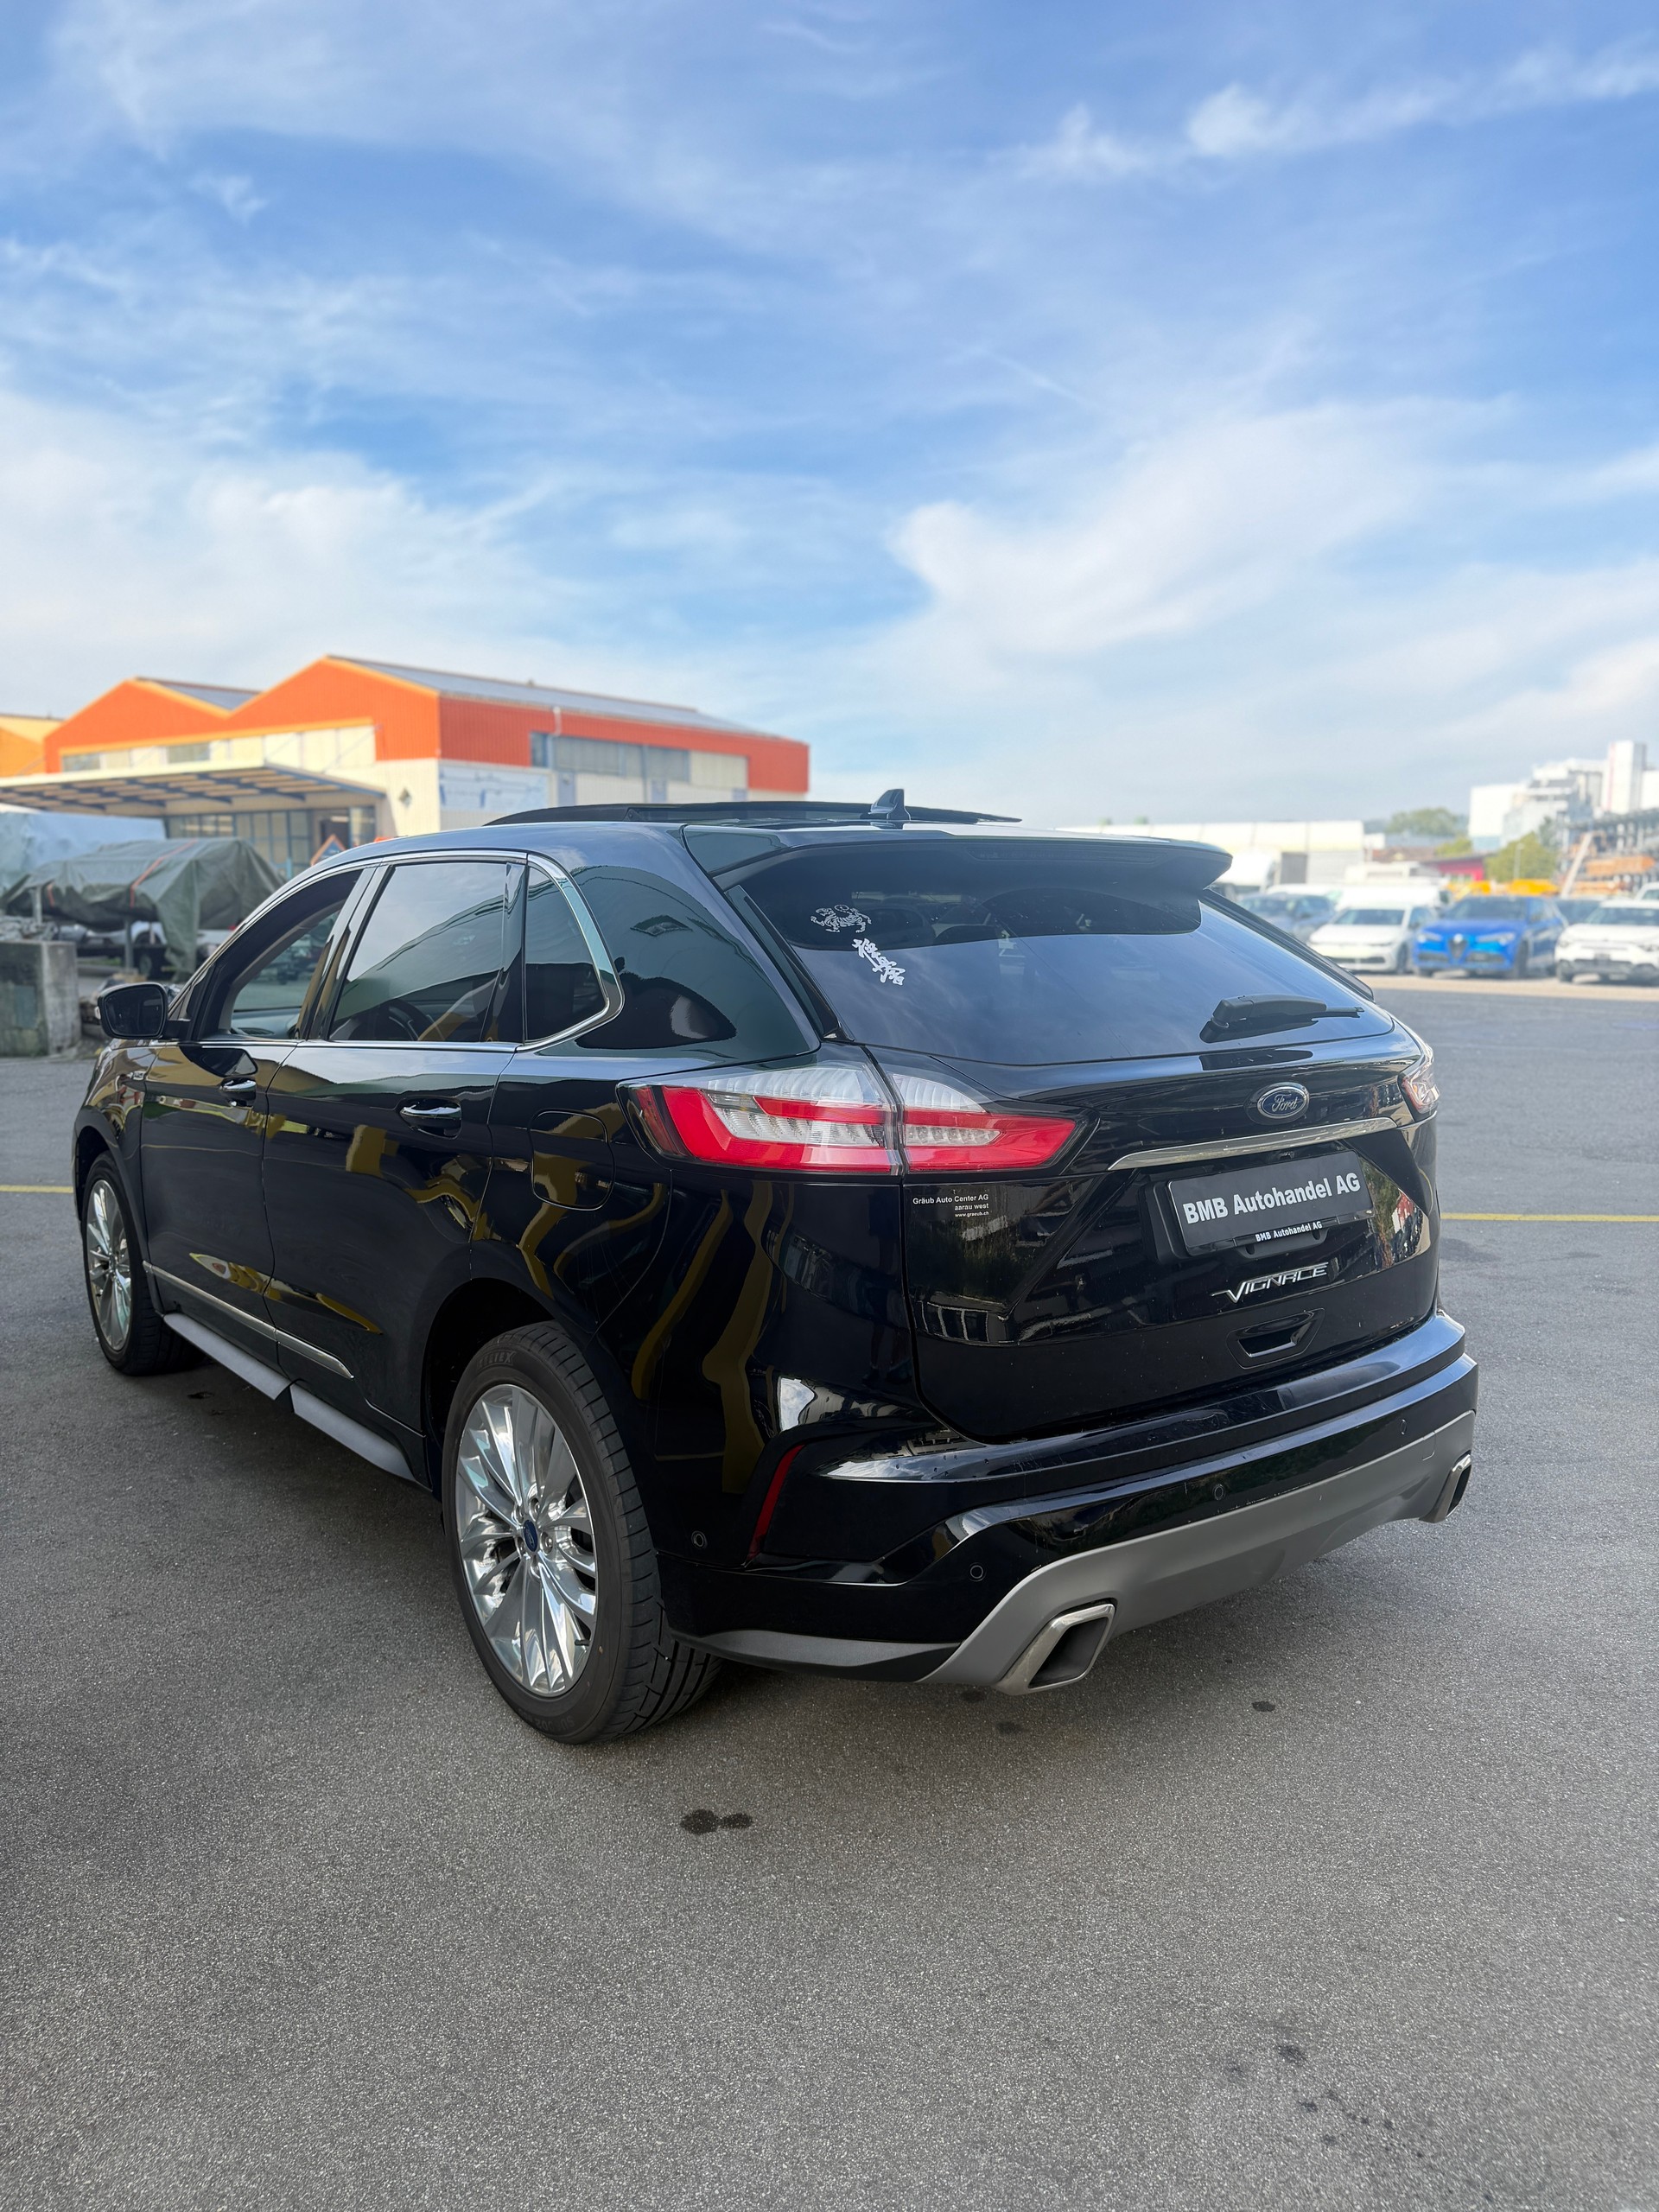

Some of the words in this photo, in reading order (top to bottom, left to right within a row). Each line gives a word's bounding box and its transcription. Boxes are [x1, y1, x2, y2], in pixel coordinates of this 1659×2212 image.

[1272, 1093, 1299, 1112] Ford
[1183, 1198, 1228, 1224] BMB
[1234, 1178, 1332, 1215] Autohandel
[1336, 1173, 1361, 1194] AG
[1255, 1231, 1272, 1242] BMB
[1274, 1223, 1312, 1238] Autohandel
[1312, 1221, 1323, 1230] AG
